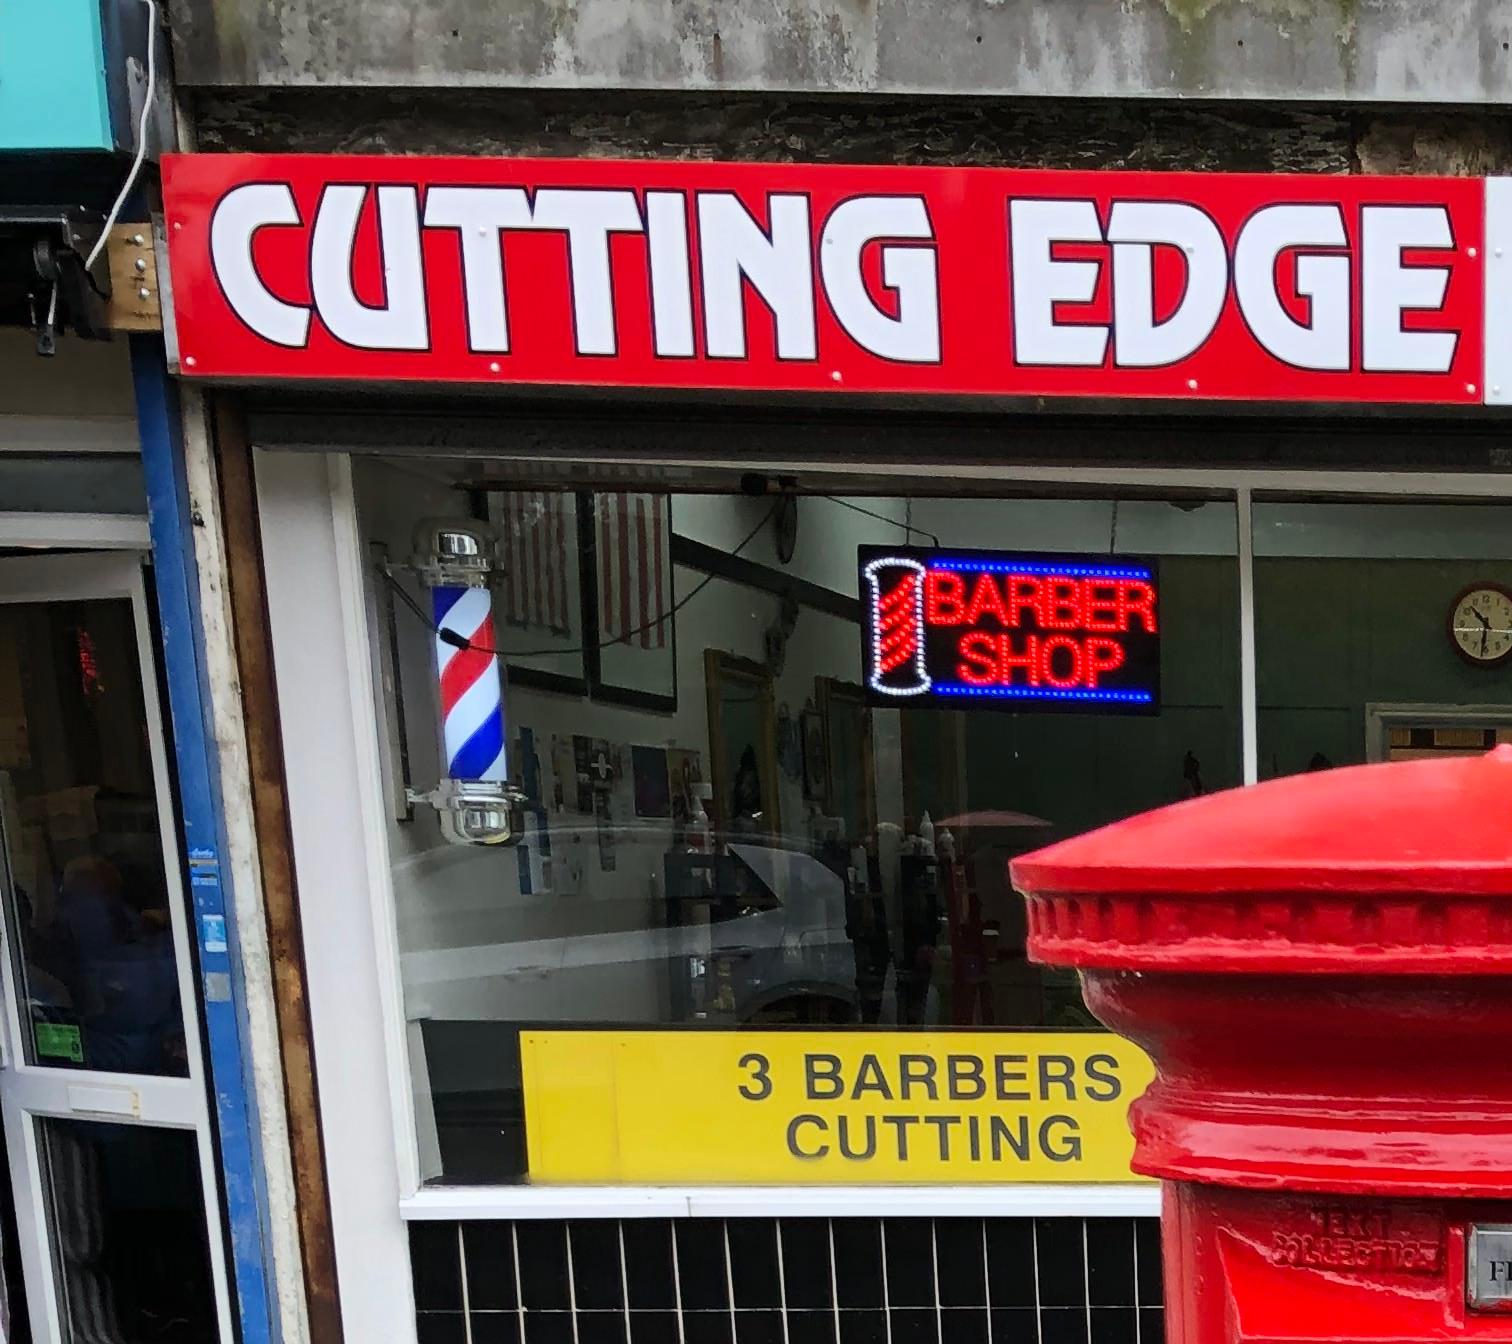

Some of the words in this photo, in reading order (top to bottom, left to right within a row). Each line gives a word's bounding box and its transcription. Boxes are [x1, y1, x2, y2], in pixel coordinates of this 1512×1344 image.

[208, 180, 944, 366] CUTTING
[1007, 196, 1461, 374] EDGE
[924, 570, 1157, 633] BARBER
[956, 630, 1125, 688] SHOP
[738, 1053, 772, 1100] 3
[804, 1054, 1122, 1101] BARBERS
[787, 1114, 1082, 1162] CUTTING
